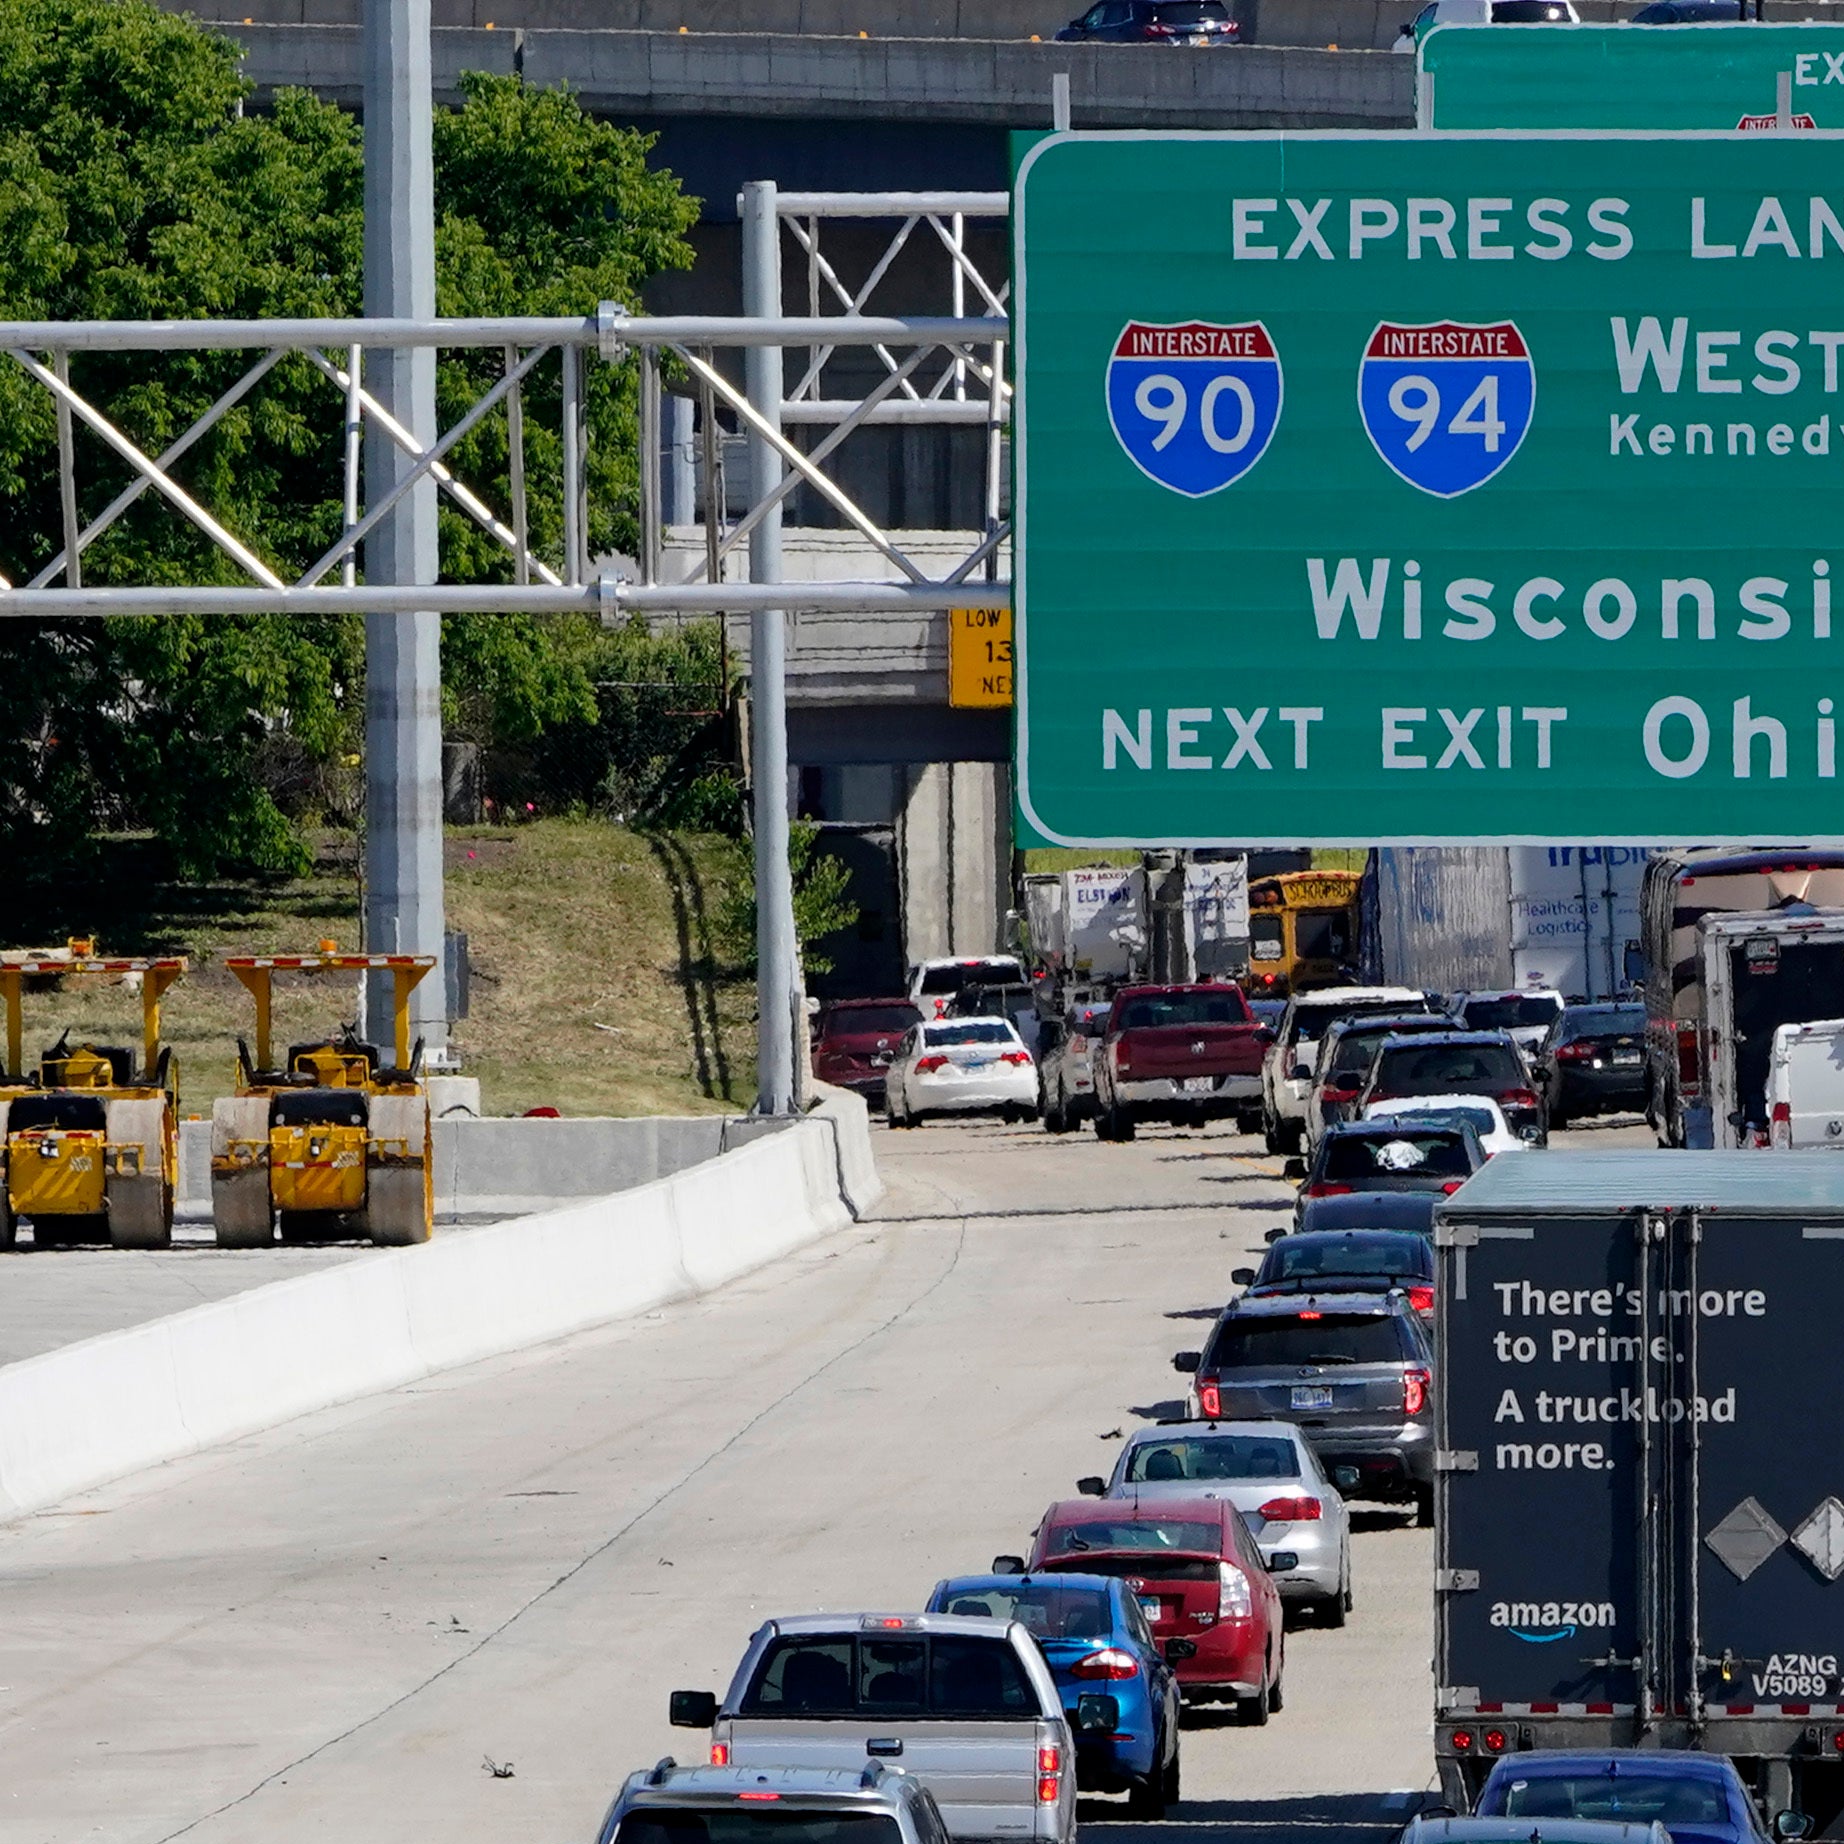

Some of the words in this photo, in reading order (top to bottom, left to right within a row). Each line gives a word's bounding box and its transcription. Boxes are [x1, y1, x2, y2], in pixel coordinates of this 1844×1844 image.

[1231, 197, 1633, 261] EXPRESS
[1131, 331, 1257, 357] INTERSTATE
[1383, 331, 1509, 357] INTERSTATE
[1134, 373, 1256, 455] 90
[1385, 373, 1507, 455] 94
[966, 609, 1001, 627] LOW
[982, 676, 1012, 694] NE
[1102, 707, 1324, 772] NEXT
[1382, 706, 1569, 771] EXIT
[1519, 900, 1599, 917] Healthcare
[1528, 919, 1593, 936] Logistics
[1492, 1280, 1644, 1316] There's
[1658, 1288, 1767, 1317] more
[1492, 1330, 1538, 1363] to
[1551, 1326, 1685, 1364] Prime.
[1494, 1388, 1525, 1423] A
[1535, 1387, 1736, 1423] truckload
[1496, 1442, 1616, 1470] more.
[1489, 1601, 1616, 1628] amazon
[1764, 1654, 1837, 1677] AZNG
[1752, 1673, 1827, 1698] V5089
